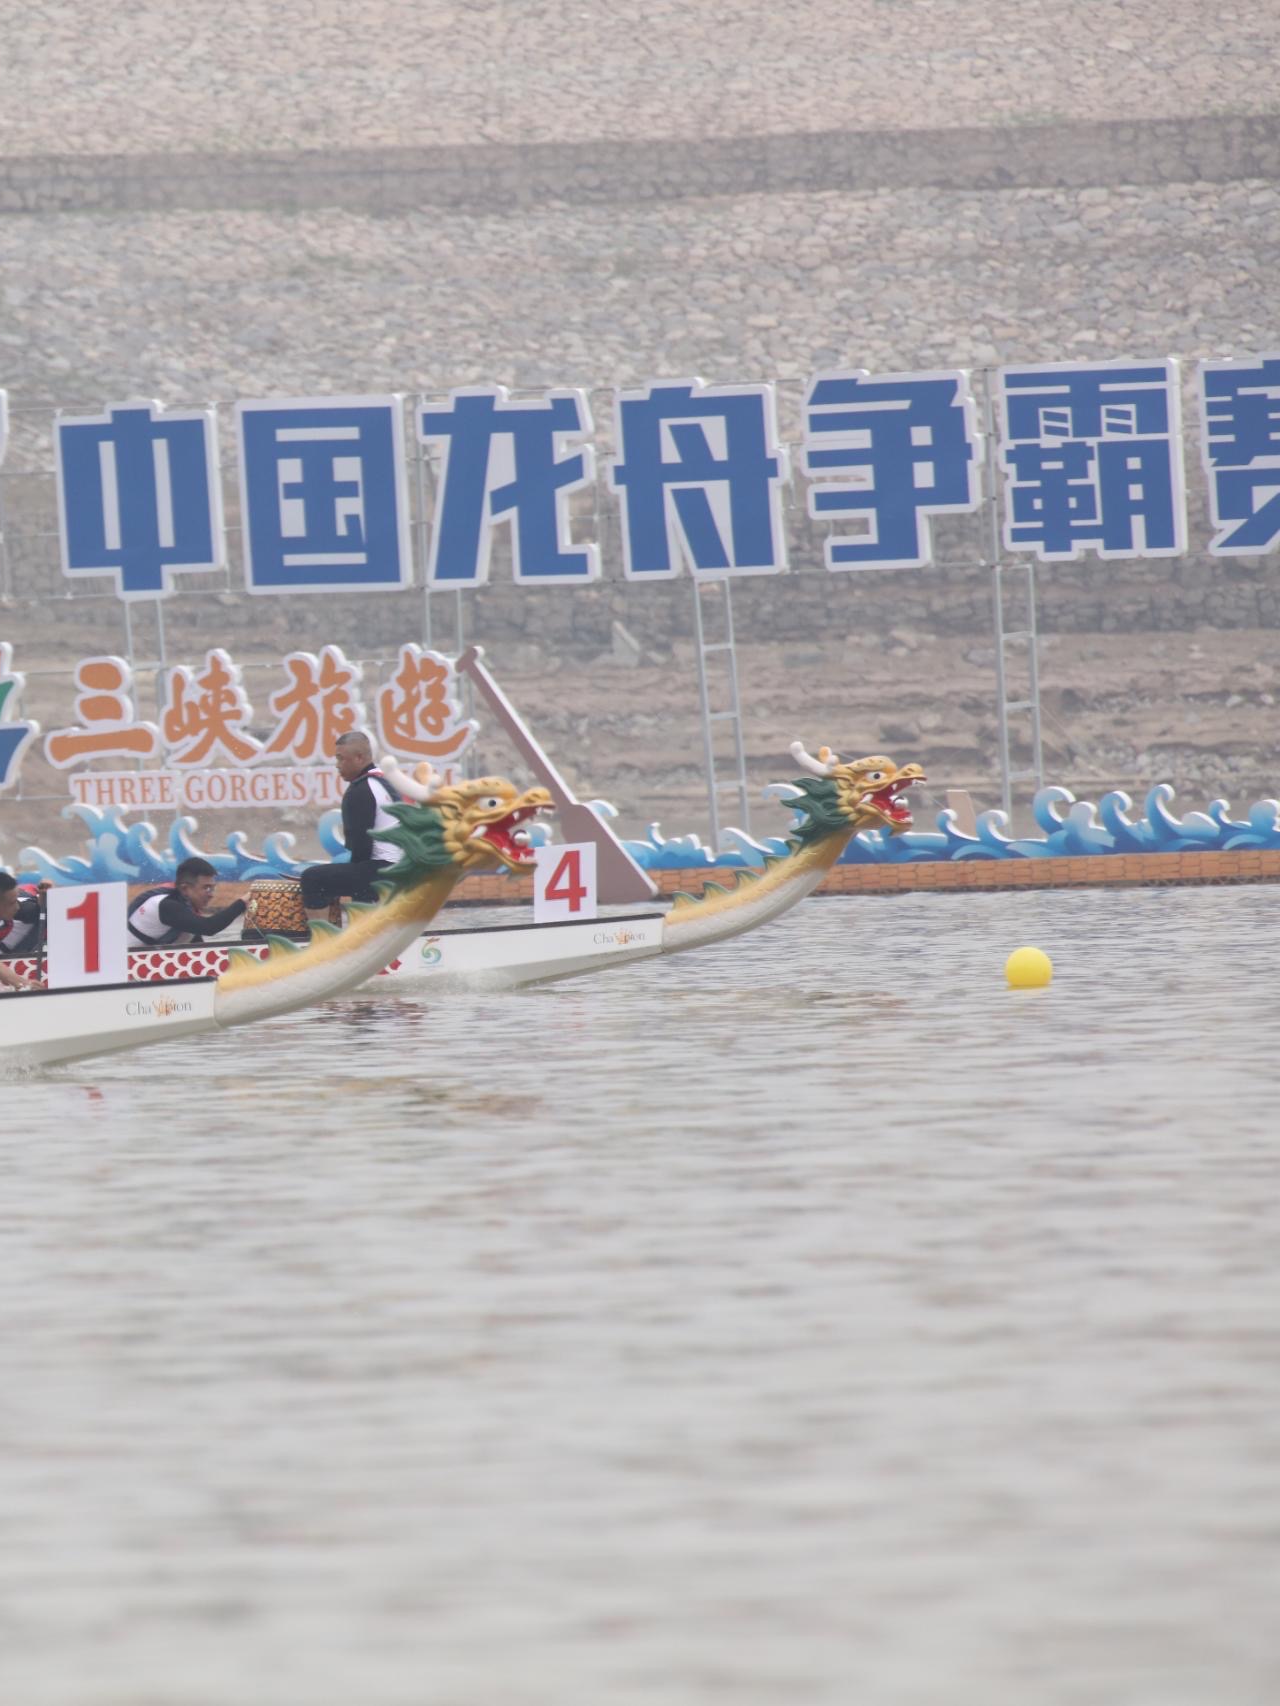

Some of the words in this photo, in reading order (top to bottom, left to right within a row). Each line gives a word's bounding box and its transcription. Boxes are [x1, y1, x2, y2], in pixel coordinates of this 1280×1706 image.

[74, 776, 174, 804] THREE
[184, 773, 307, 803] GORGES
[544, 850, 588, 912] 4
[66, 891, 99, 974] 1
